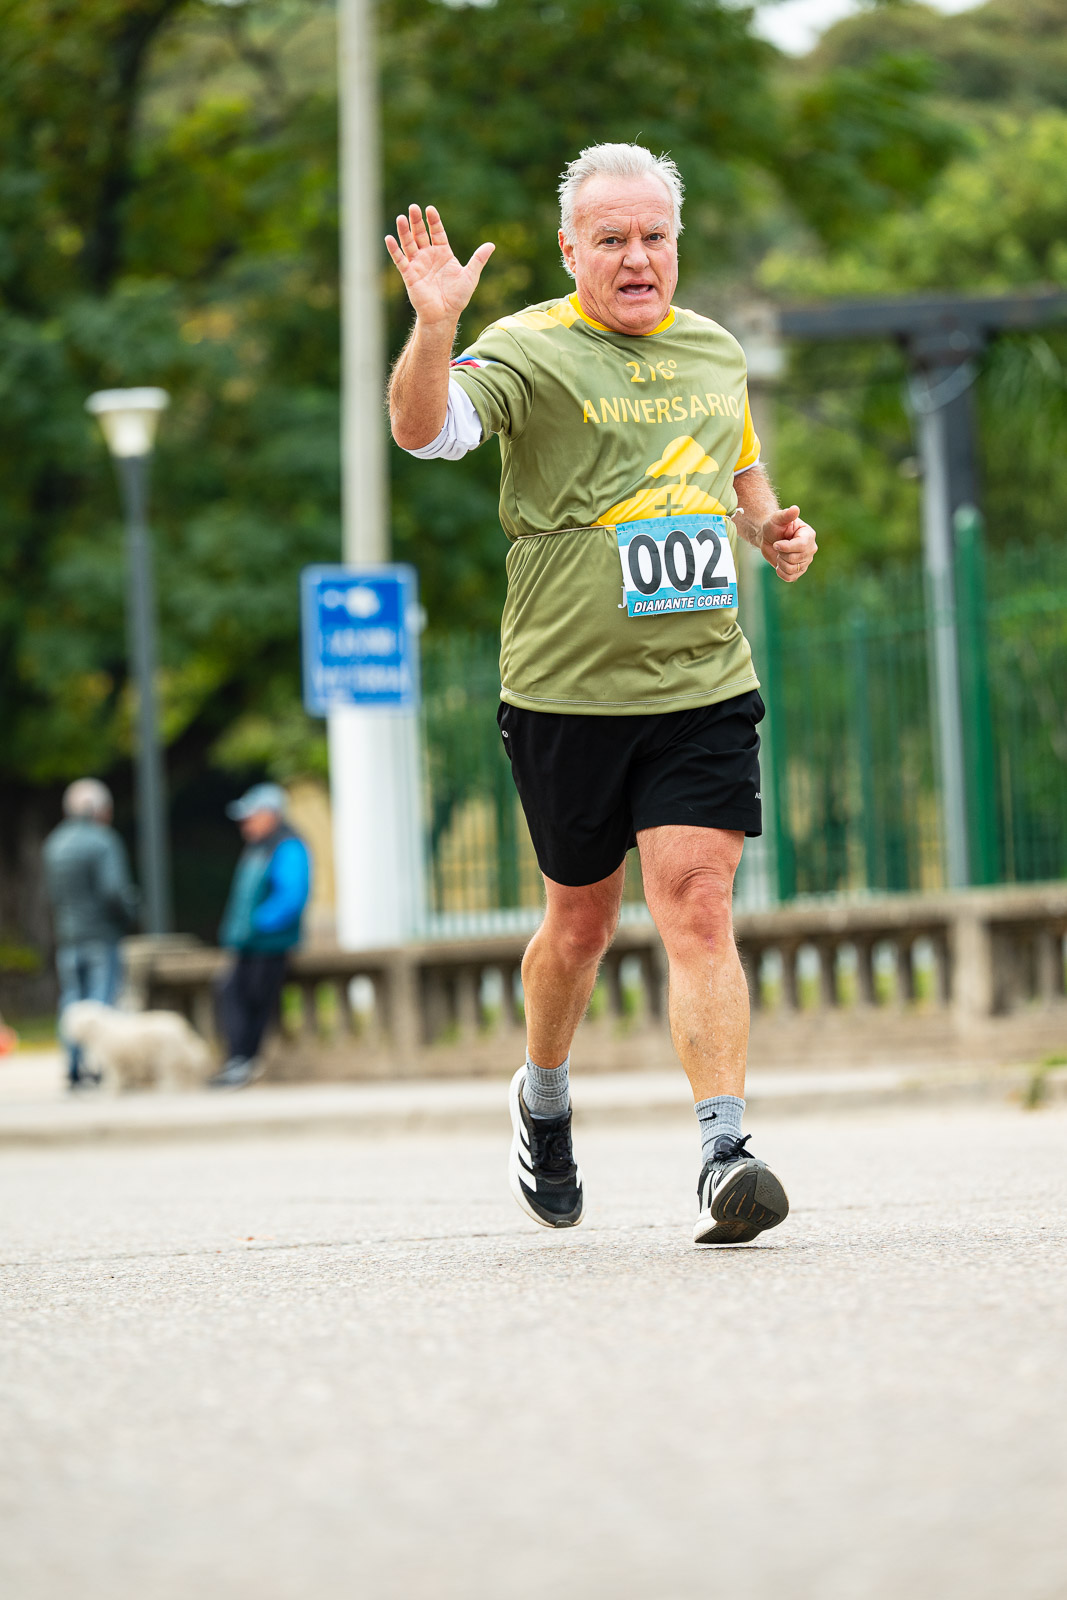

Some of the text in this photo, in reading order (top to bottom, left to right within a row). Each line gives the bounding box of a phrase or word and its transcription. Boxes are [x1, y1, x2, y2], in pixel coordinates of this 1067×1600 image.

[583, 393, 740, 424] ANIVERSARIO
[627, 528, 729, 596] 002
[633, 596, 695, 613] DIAMANTE
[697, 594, 733, 608] CORRE
